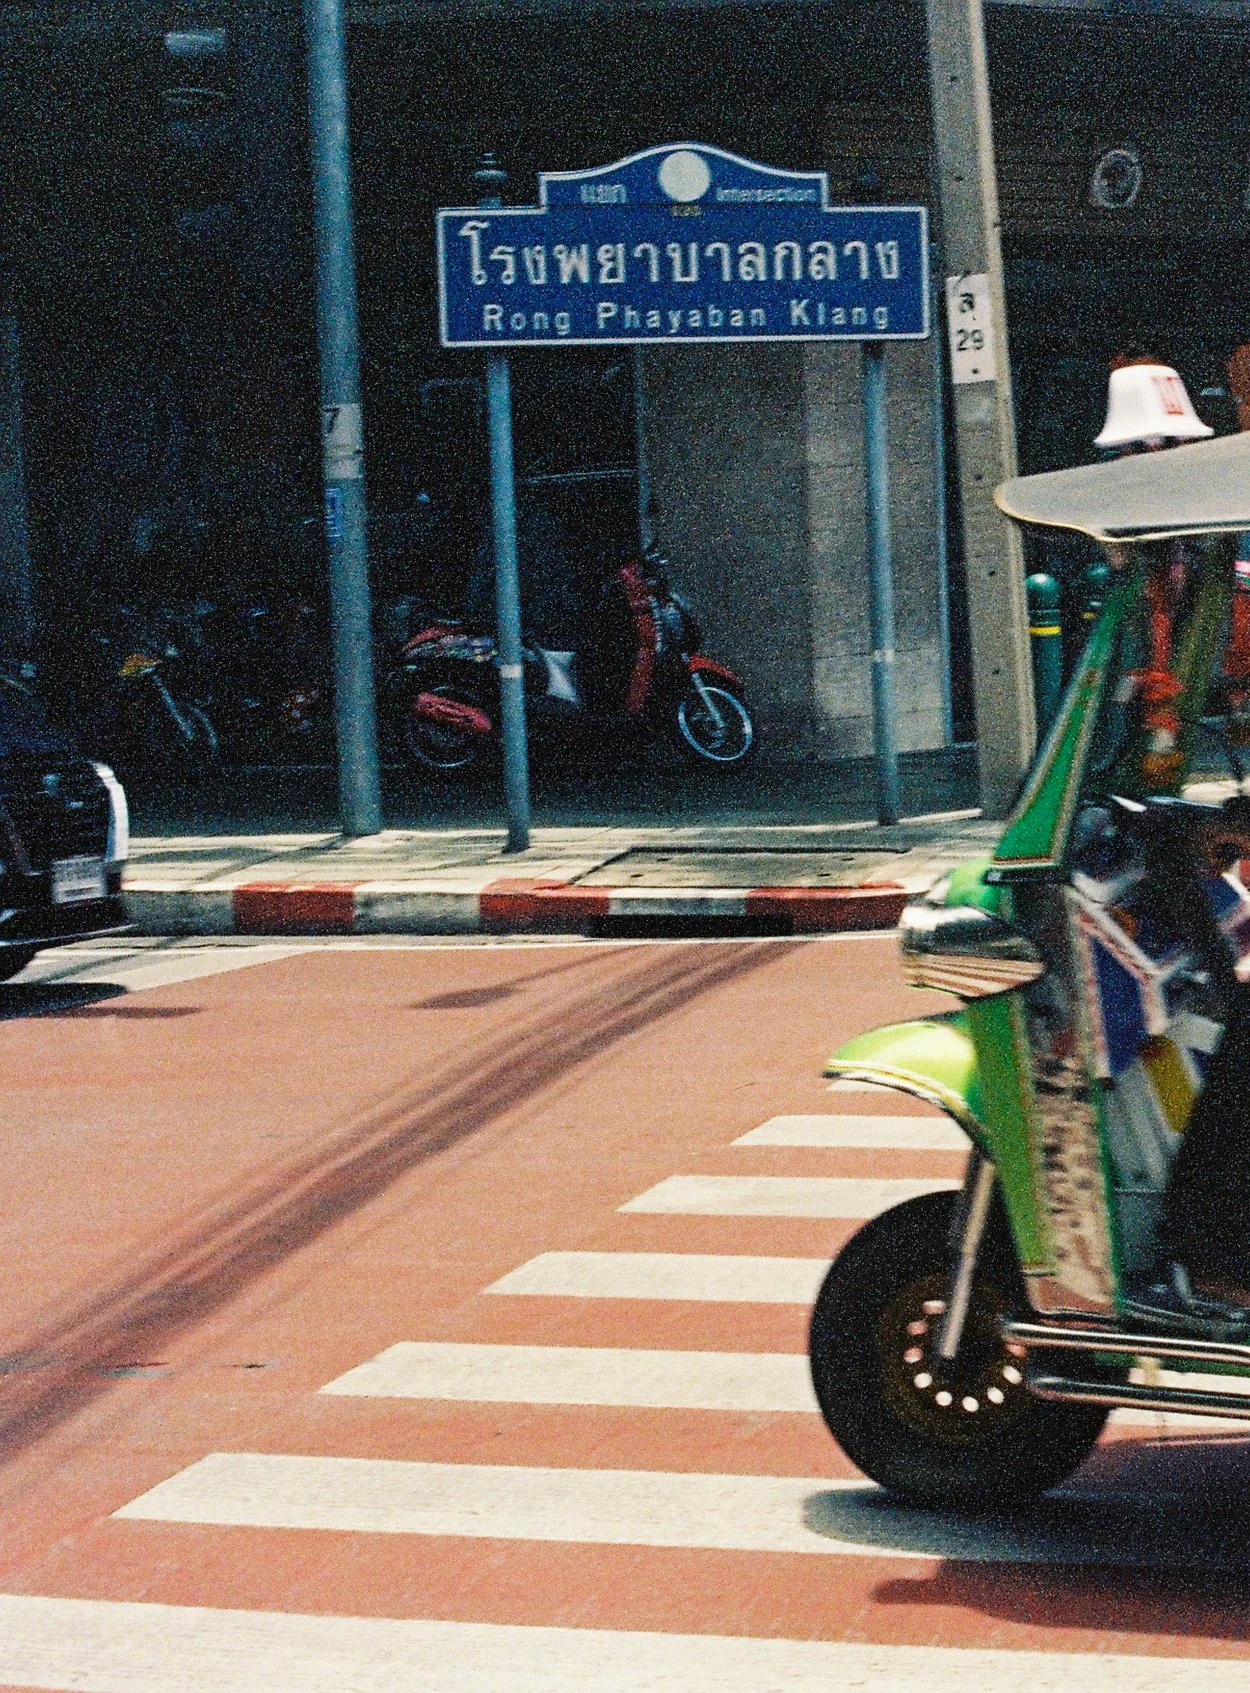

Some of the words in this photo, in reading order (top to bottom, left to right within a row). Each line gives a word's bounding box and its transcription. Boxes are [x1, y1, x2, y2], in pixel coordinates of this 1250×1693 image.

[458, 219, 898, 285] โรงพยาบาลกลาง
[483, 303, 571, 335] Rong
[596, 301, 767, 333] Phayaban
[789, 299, 889, 330] Klang
